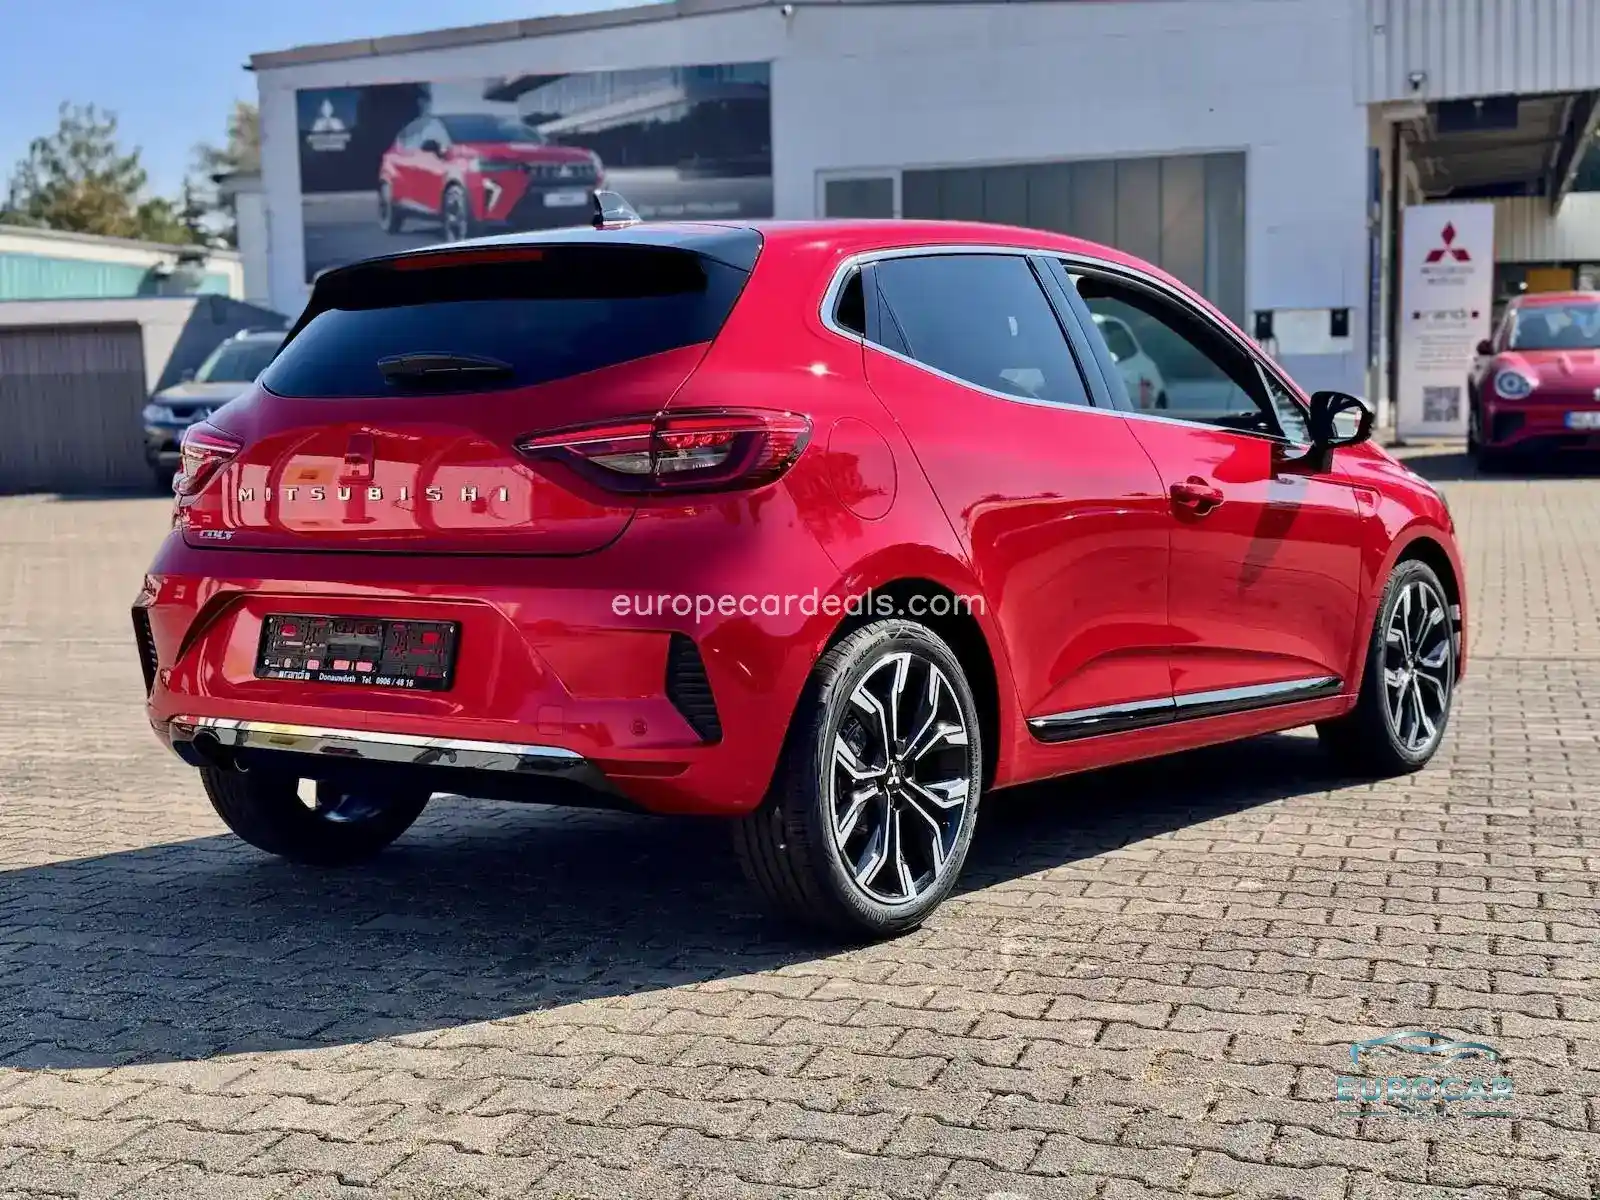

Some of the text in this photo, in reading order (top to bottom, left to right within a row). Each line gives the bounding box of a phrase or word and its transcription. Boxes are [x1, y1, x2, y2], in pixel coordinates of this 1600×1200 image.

[238, 486, 510, 502] MITSUBISHI
[319, 672, 356, 683] Donauwörth
[375, 676, 391, 686] 0906
[396, 678, 404, 687] 48
